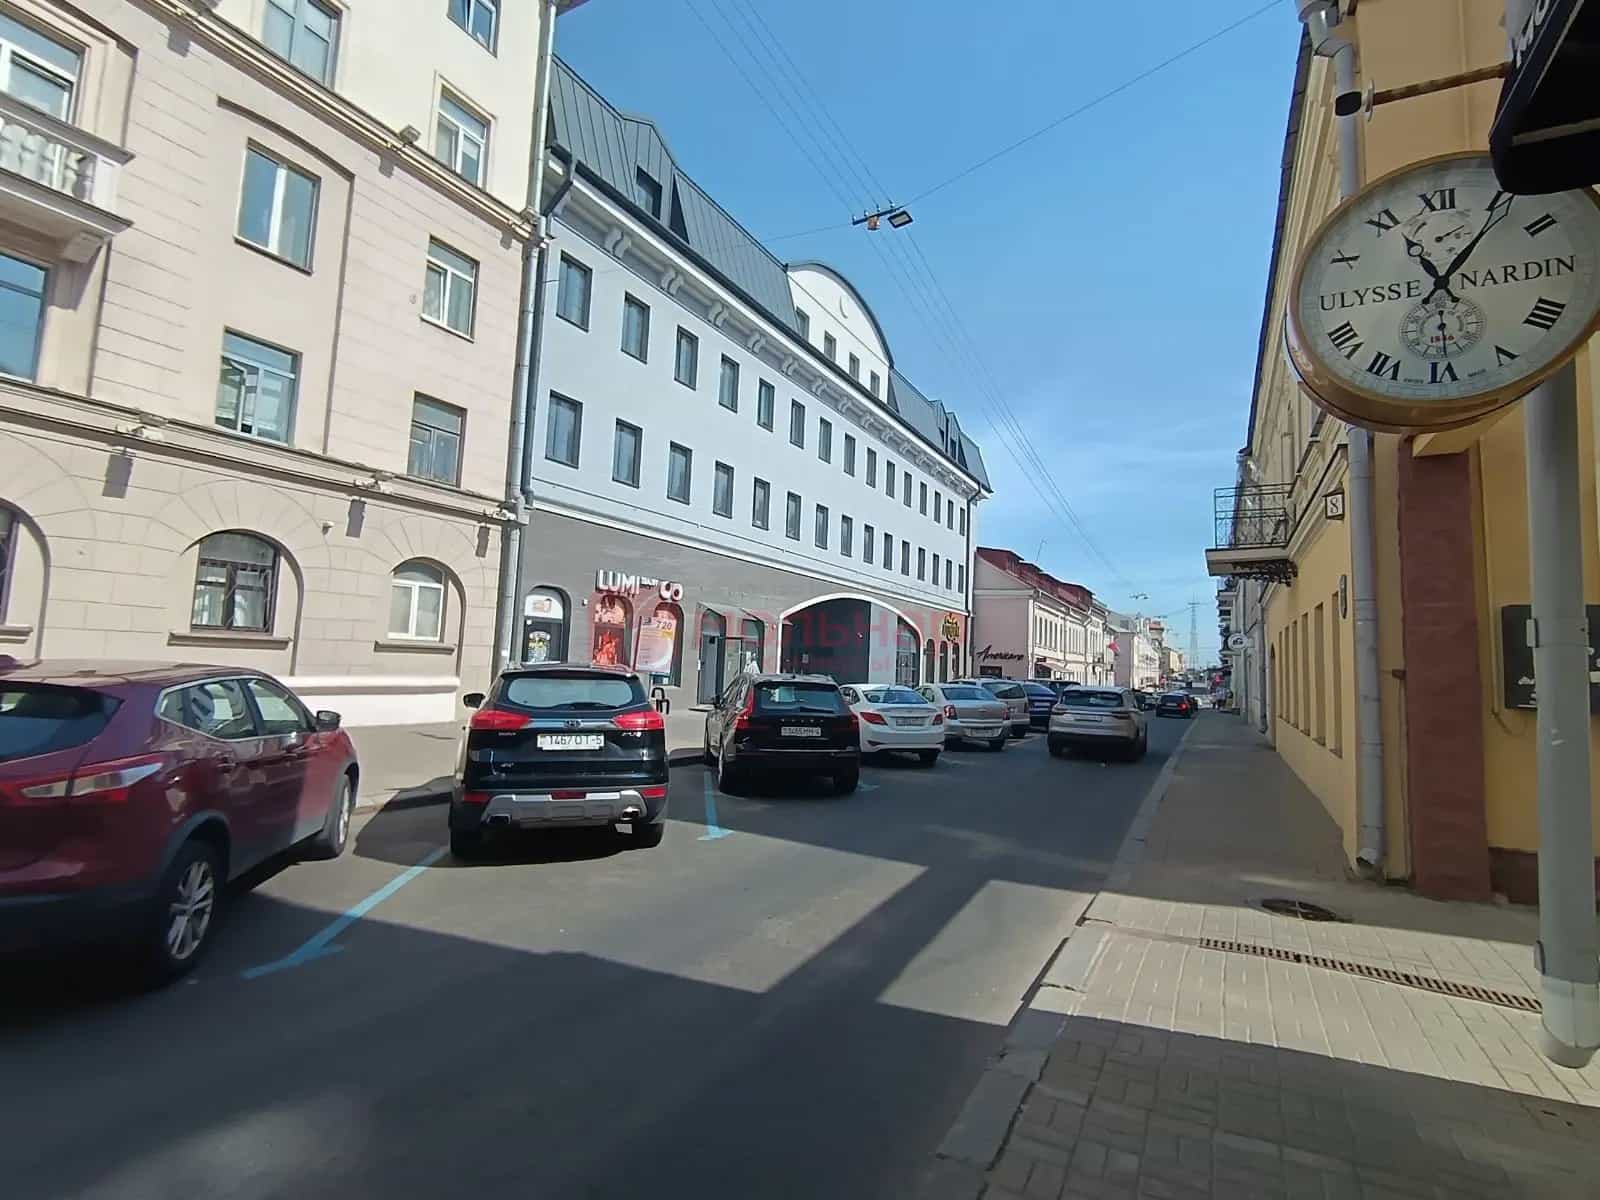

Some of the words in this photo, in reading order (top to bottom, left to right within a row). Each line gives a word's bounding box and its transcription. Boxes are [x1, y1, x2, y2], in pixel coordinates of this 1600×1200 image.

[1417, 188, 1456, 212] XII
[1365, 208, 1401, 237] XI
[1319, 280, 1422, 312] ULYSSE
[1459, 254, 1577, 290] NARDIN
[597, 569, 641, 595] LUMI
